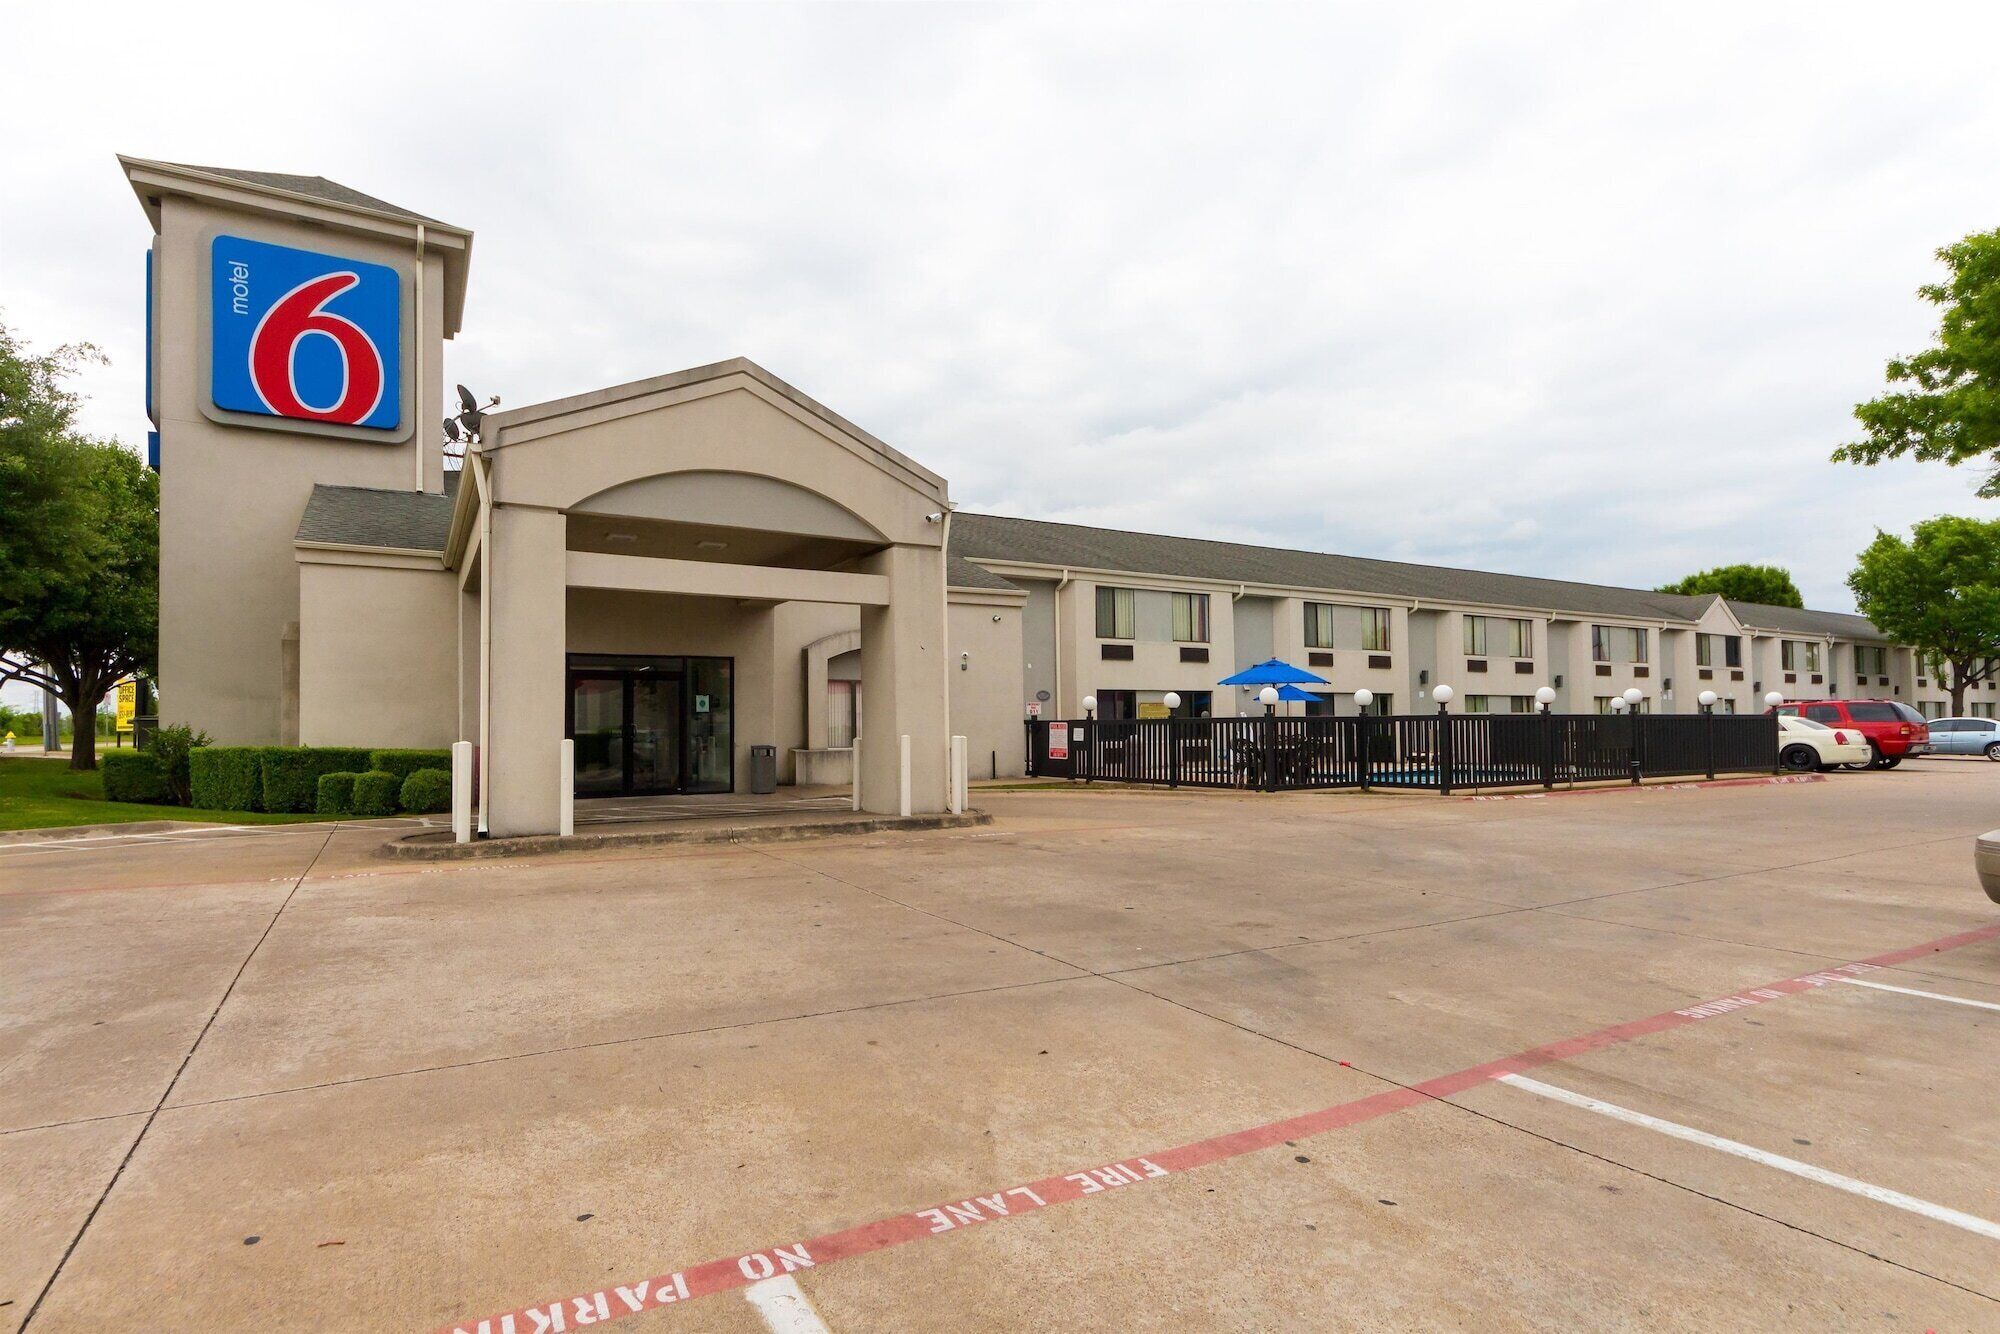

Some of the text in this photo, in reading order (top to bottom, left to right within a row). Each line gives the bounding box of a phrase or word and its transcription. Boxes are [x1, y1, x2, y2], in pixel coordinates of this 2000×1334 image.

[228, 260, 249, 315] motel
[248, 271, 385, 425] 6
[119, 694, 134, 702] SPACE
[1673, 996, 1760, 1019] PARKING
[1065, 1158, 1170, 1194] FIRE
[916, 1187, 1046, 1233] LANE
[738, 1243, 815, 1280] NO
